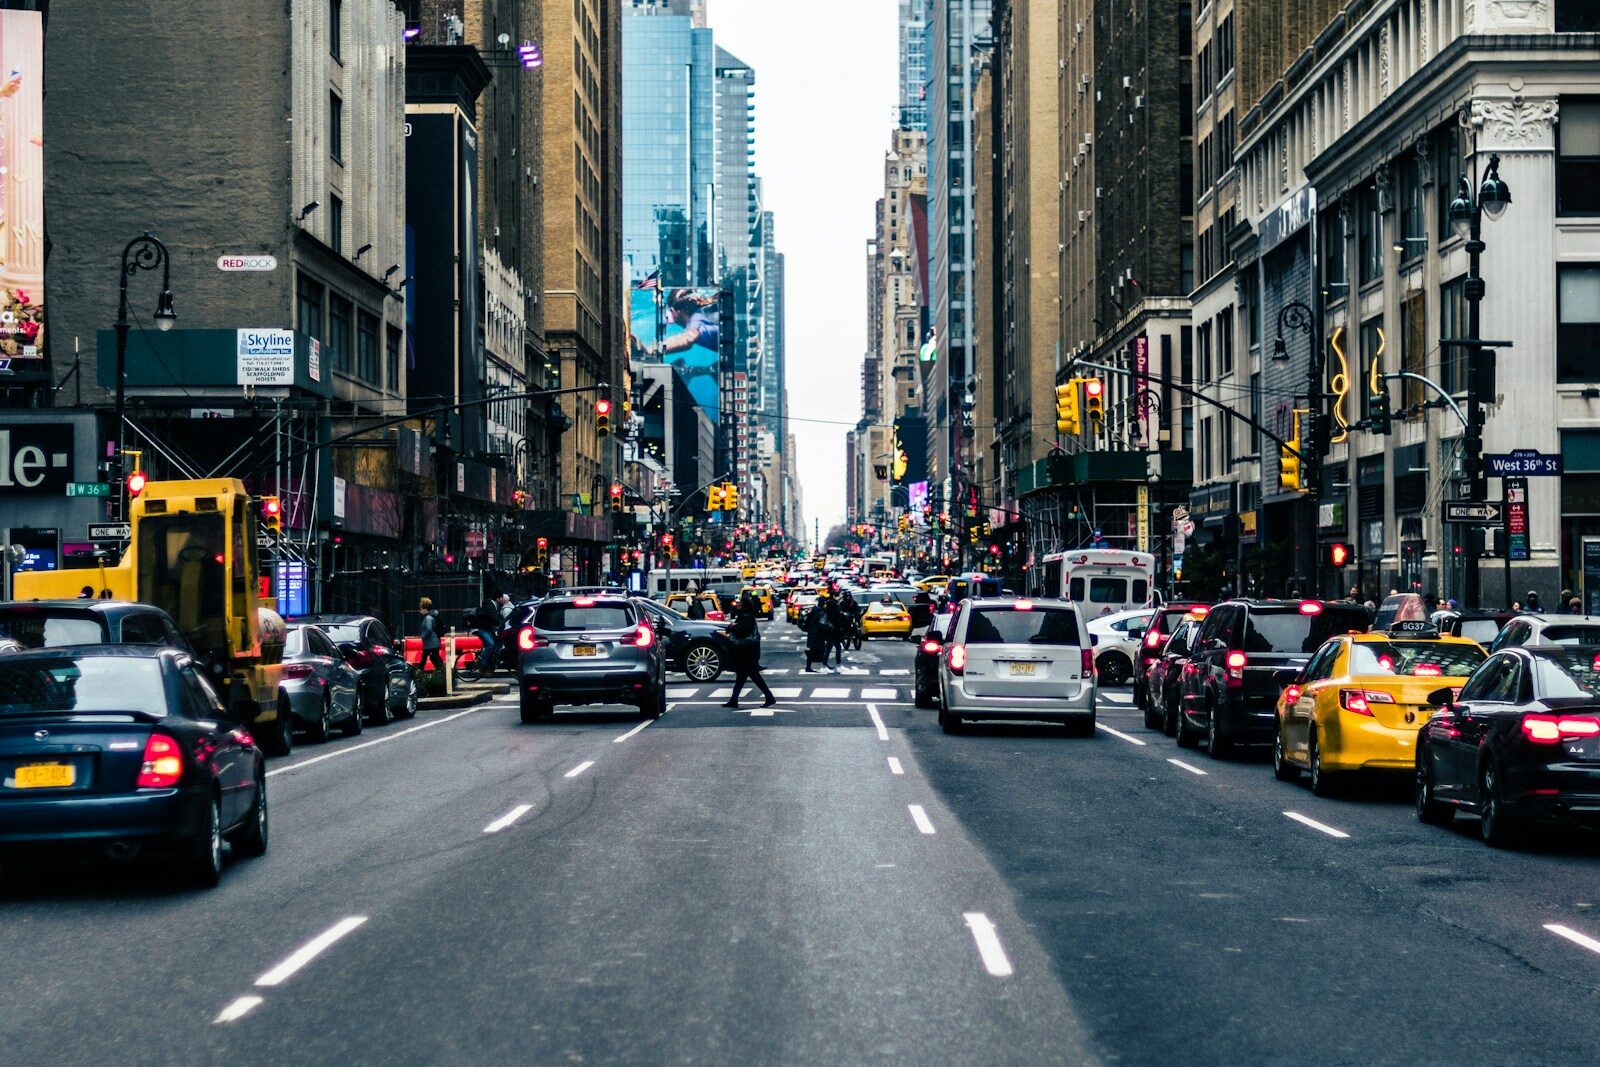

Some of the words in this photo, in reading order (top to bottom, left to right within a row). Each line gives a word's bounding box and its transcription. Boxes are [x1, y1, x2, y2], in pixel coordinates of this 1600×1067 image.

[223, 259, 271, 267] REDROCK
[248, 333, 291, 349] Skyline
[1493, 460, 1520, 471] West
[1523, 459, 1543, 471] 36th
[1546, 460, 1557, 471] St
[78, 485, 84, 494] W
[87, 485, 99, 495] 36
[1456, 508, 1470, 516] ONE
[1477, 508, 1493, 516] WAY
[95, 528, 109, 536] ONE
[116, 528, 130, 536] WAY
[1402, 622, 1425, 631] 6G37
